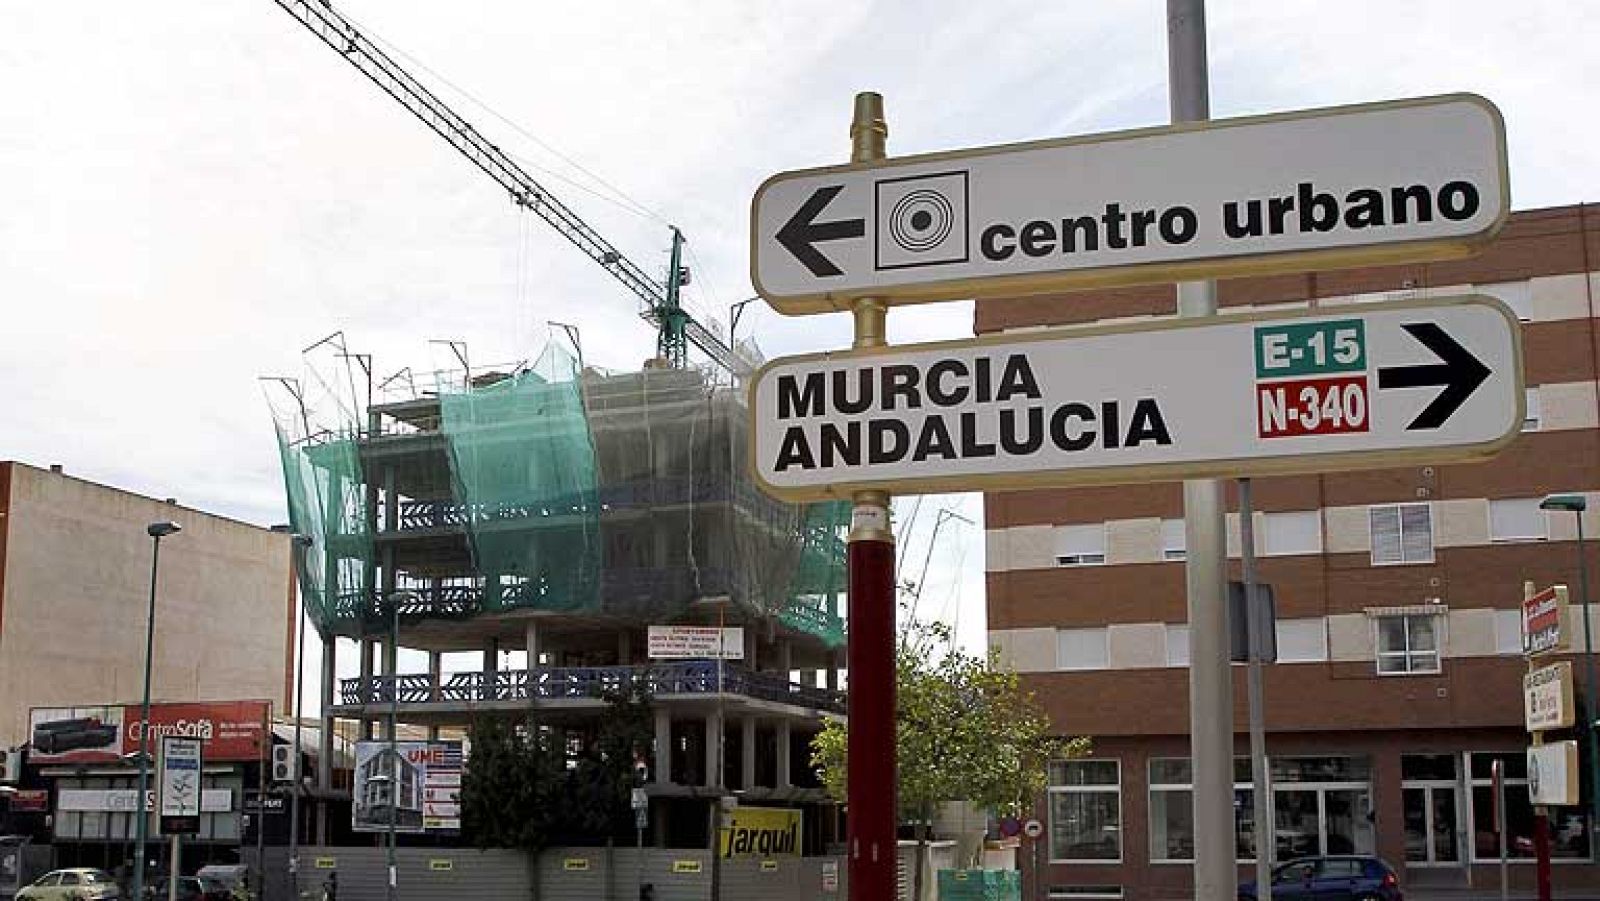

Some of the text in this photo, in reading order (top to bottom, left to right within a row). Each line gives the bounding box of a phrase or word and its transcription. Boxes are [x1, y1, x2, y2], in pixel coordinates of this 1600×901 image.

[980, 180, 1480, 262] centro urbano
[1263, 328, 1360, 369] E-15
[778, 355, 1042, 420] MURCIA
[1260, 383, 1365, 433] N-340
[775, 399, 1172, 472] ANDALUCIA
